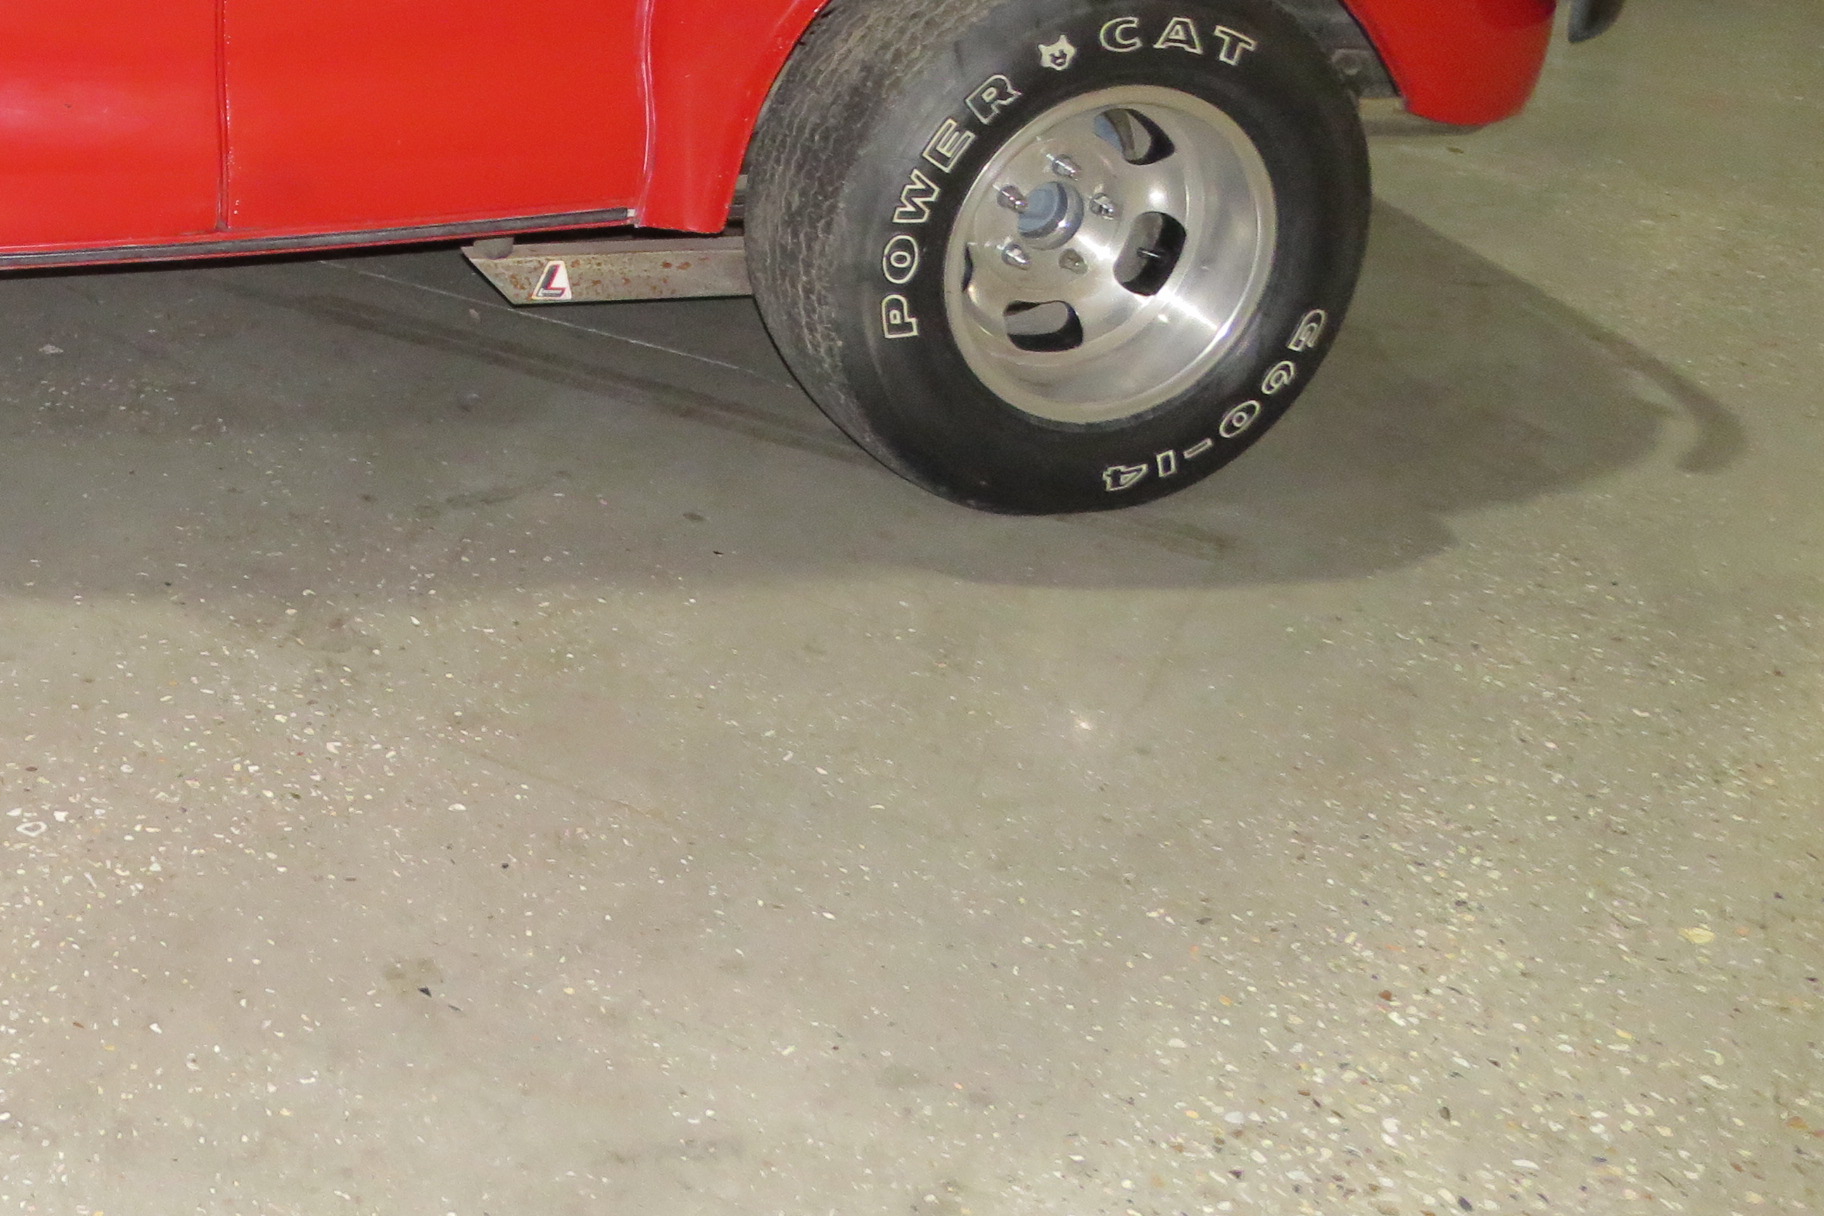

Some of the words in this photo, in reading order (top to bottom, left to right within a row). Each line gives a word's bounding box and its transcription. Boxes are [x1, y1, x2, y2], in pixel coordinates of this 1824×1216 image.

[880, 74, 1021, 339] POWER
[1099, 16, 1256, 66] CAT
[1103, 308, 1327, 491] G60-14
